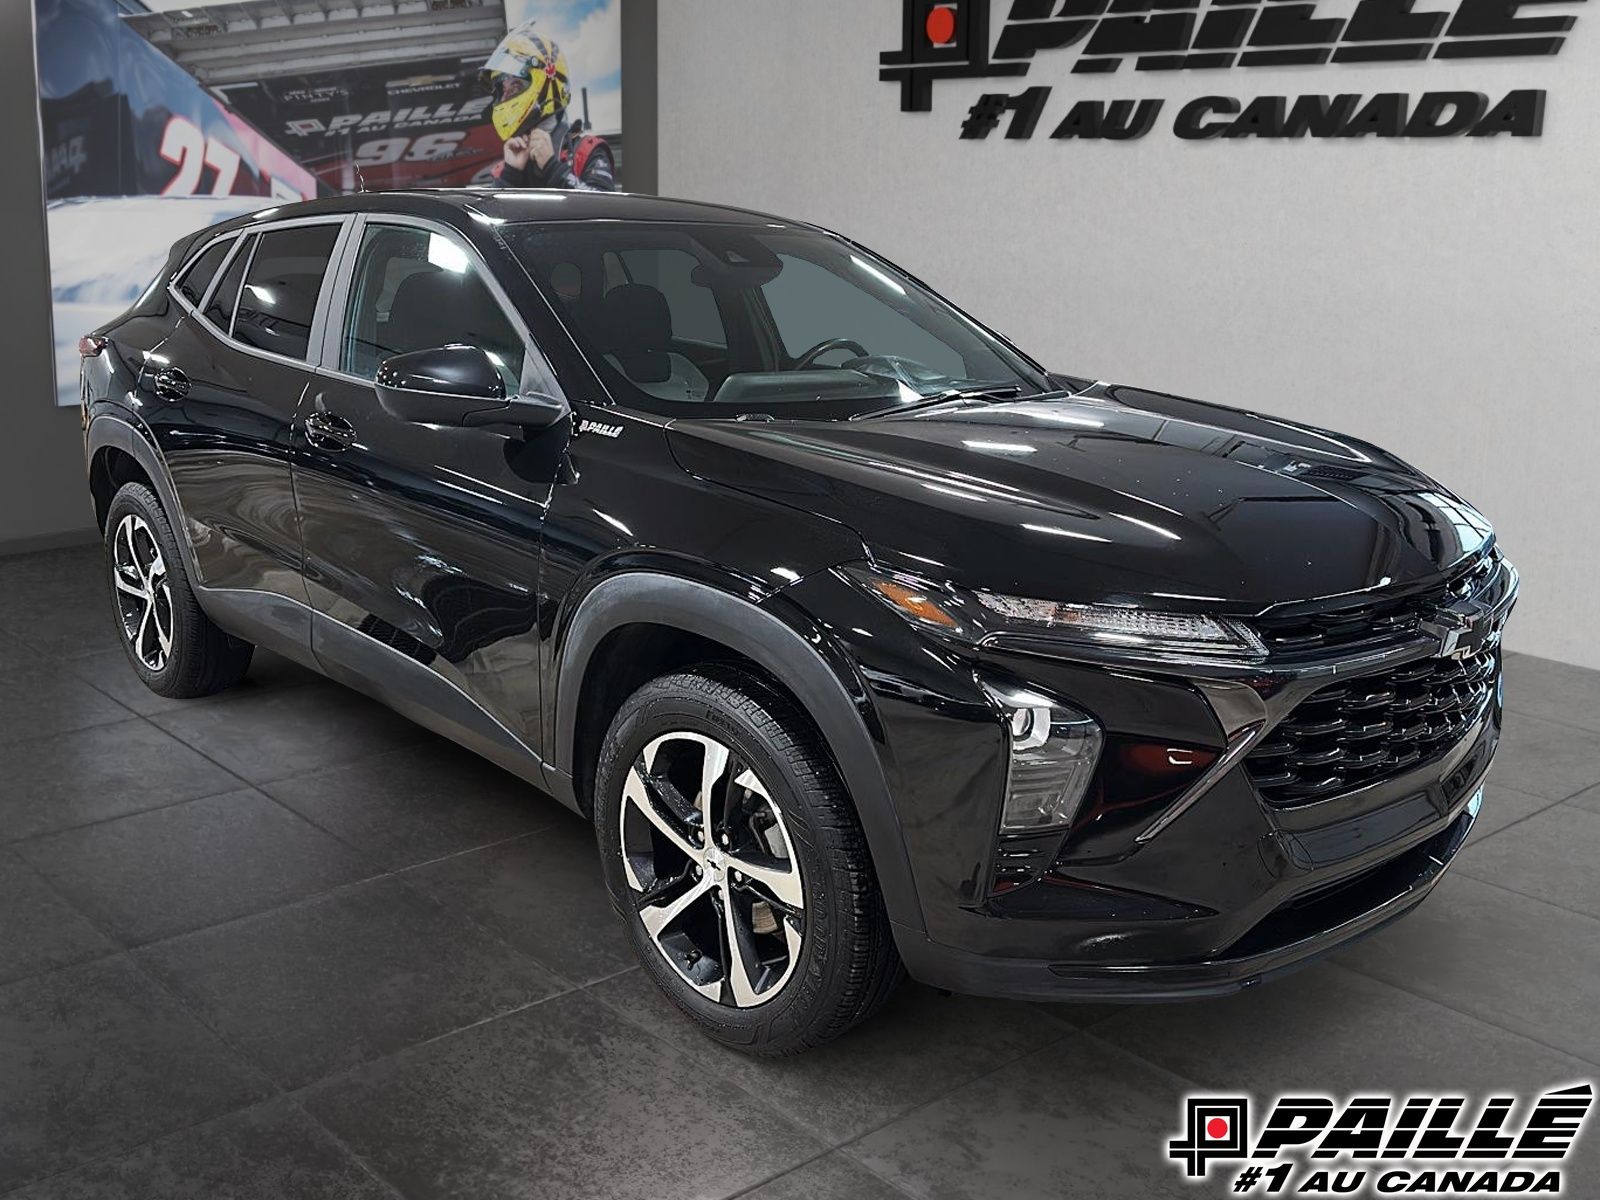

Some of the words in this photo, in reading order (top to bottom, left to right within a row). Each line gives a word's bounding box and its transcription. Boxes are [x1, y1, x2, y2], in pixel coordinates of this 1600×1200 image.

[356, 124, 387, 134] AU
[394, 113, 482, 129] CANADA
[958, 86, 1052, 140] #1
[1050, 98, 1164, 140] AU
[1173, 89, 1547, 138] CANADA
[353, 131, 466, 167] 96
